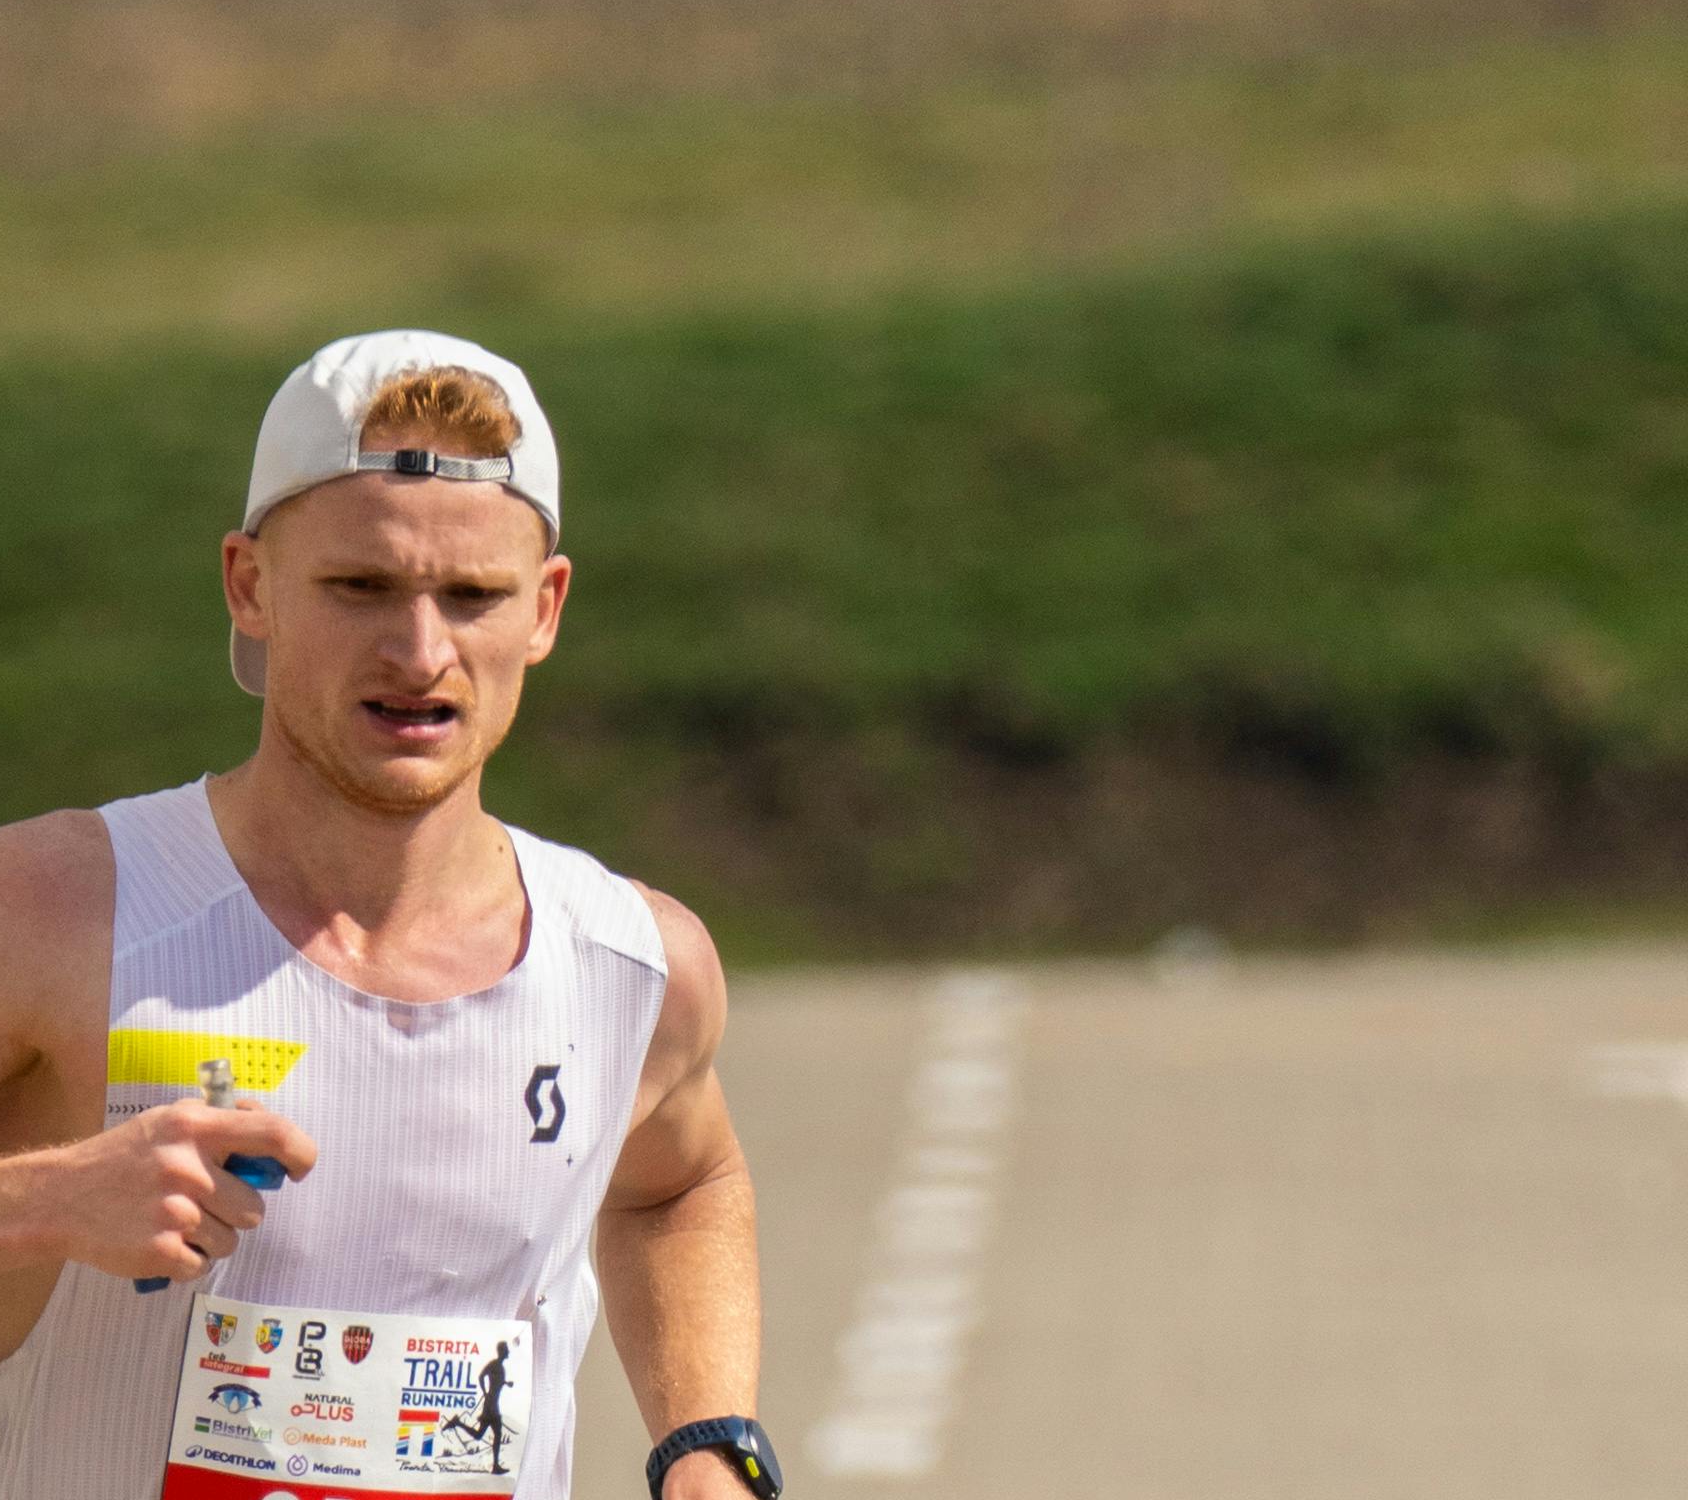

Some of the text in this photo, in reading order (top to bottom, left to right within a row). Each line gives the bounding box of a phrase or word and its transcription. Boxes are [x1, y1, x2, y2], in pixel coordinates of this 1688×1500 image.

[403, 1357, 477, 1389] TRAIL
[304, 1393, 355, 1406] NATURAL
[400, 1392, 477, 1409] RUNNING
[213, 1419, 273, 1440] BistriVet
[302, 1433, 367, 1449] Meda Plast
[203, 1447, 276, 1471] DECATHLON
[313, 1462, 361, 1476] Medima
